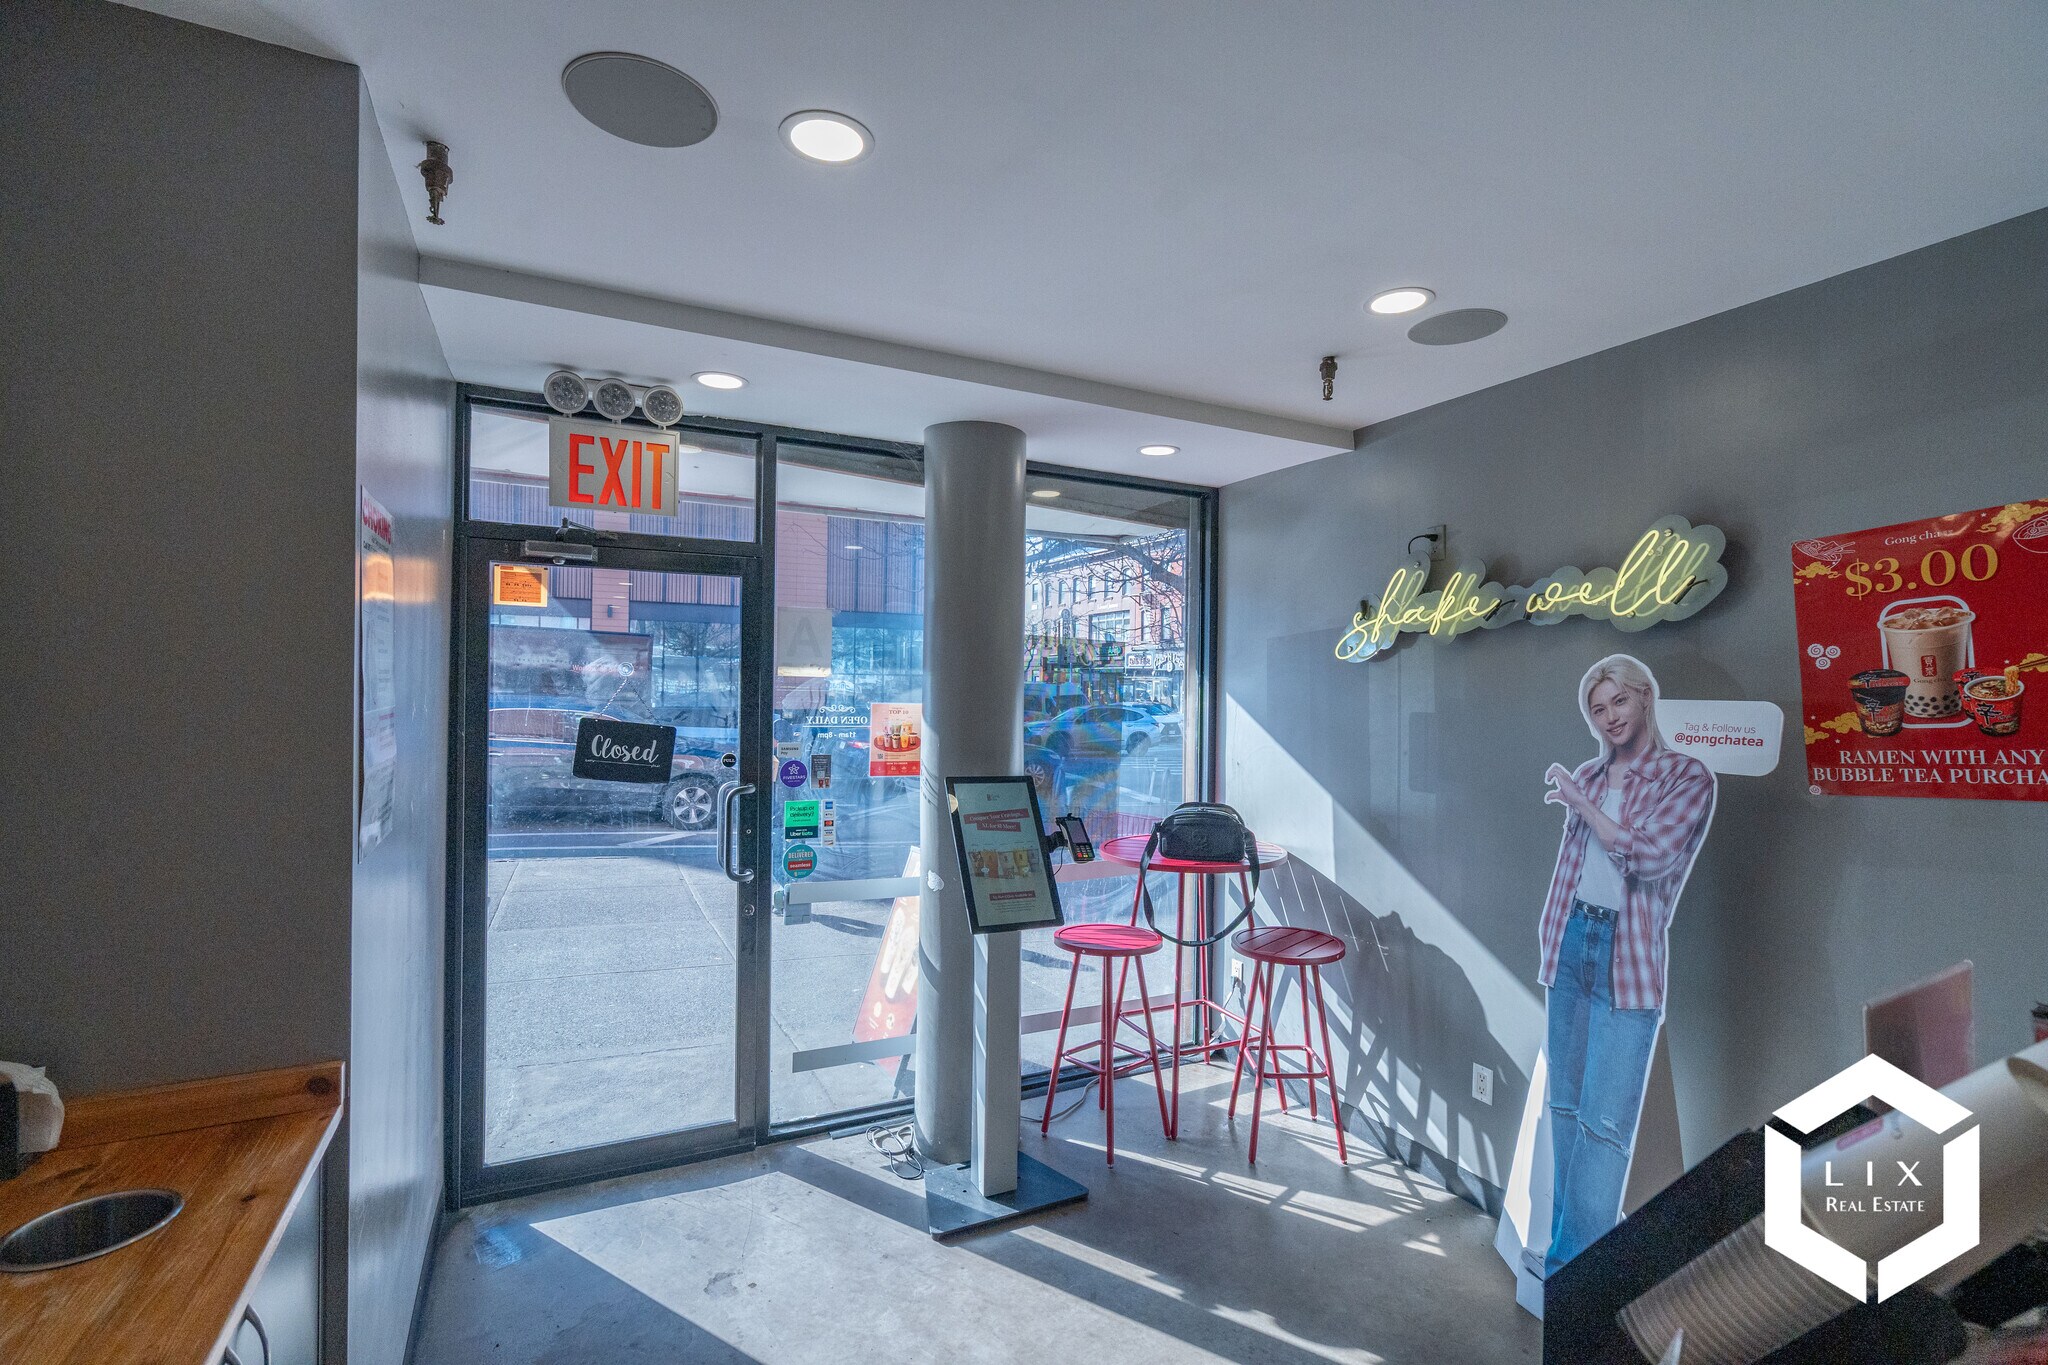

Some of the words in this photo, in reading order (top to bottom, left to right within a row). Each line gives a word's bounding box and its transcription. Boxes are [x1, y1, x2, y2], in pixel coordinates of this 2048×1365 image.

[568, 433, 670, 510] EXIT
[1884, 534, 1917, 546] Gong
[1919, 530, 1941, 540] cha
[1845, 543, 1999, 600] $3.00
[1335, 568, 1500, 660] shake
[1526, 530, 1696, 616] well
[1684, 722, 1700, 734] Tag
[1701, 723, 1710, 732] &
[1711, 723, 1742, 734] Follow
[1744, 726, 1756, 734] us
[1674, 732, 1764, 747] @gongchatea
[591, 734, 660, 764] Closed
[1838, 749, 1915, 765] RAMEN
[1920, 749, 1987, 765] WITH
[1993, 749, 2047, 765] ANY
[1812, 767, 1895, 783] BUBBLE
[1899, 767, 1944, 784] TEA
[1949, 768, 2048, 785] PURCHA
[788, 851, 814, 859] DELIVERED
